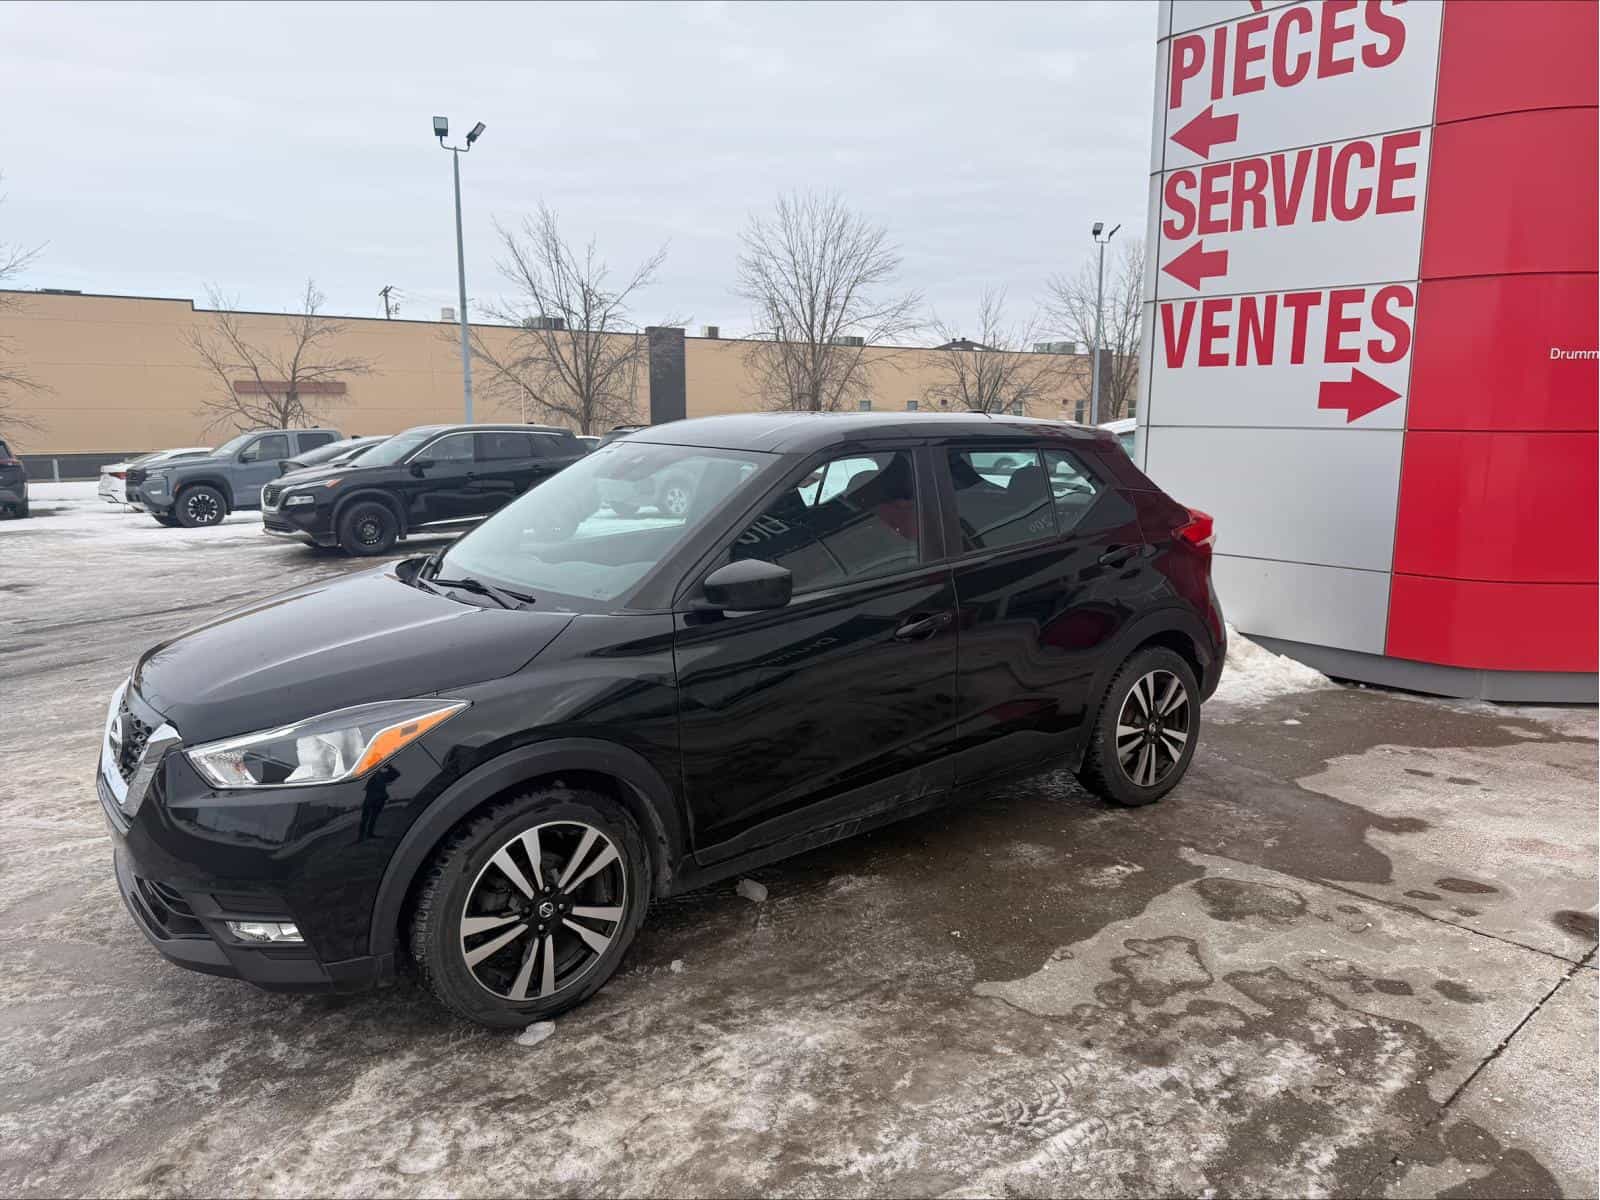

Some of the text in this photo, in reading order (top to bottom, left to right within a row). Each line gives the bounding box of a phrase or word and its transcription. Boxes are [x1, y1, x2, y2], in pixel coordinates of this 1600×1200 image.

[1170, 0, 1406, 109] PIÈCES
[1163, 131, 1421, 241] SERVICE
[1161, 285, 1415, 369] VENTES
